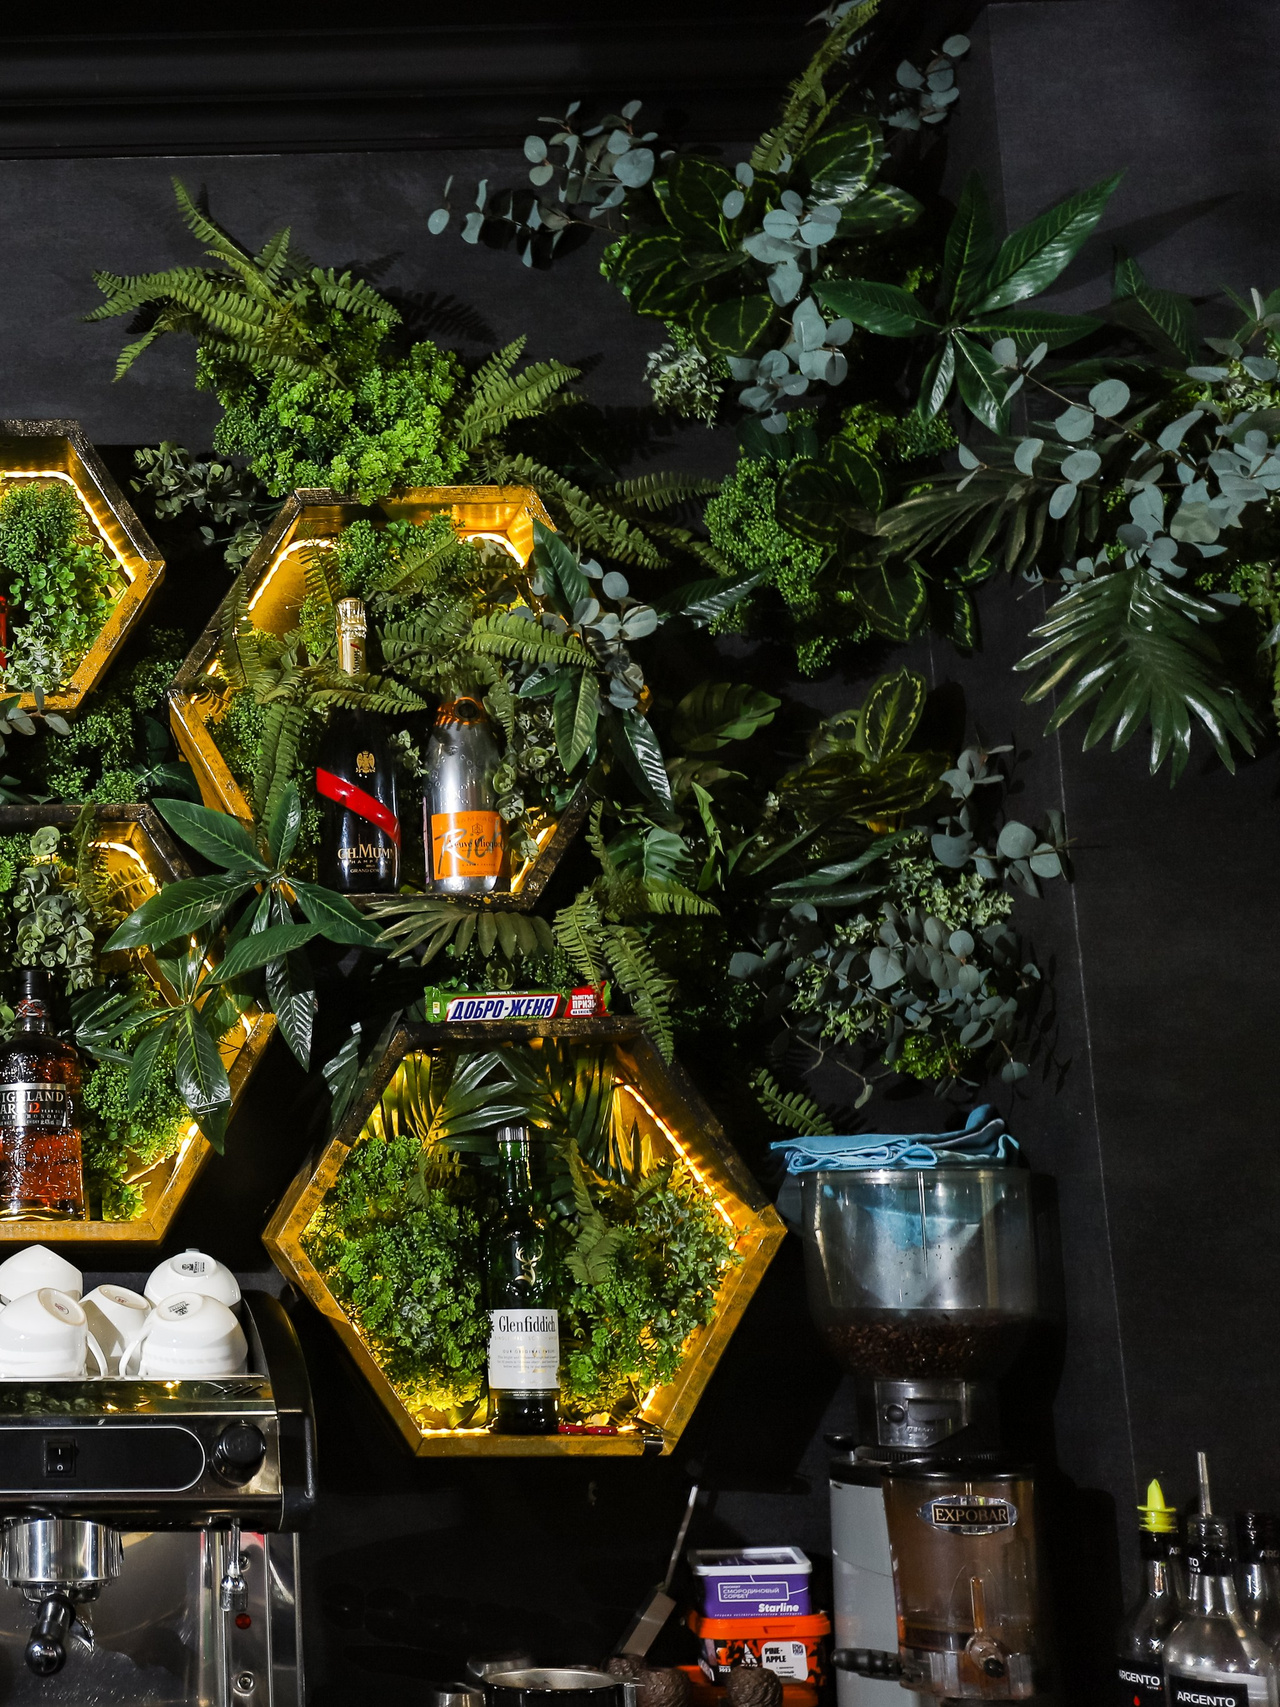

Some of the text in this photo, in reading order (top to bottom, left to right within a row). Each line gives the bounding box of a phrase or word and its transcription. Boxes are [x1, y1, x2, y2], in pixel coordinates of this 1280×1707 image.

[434, 817, 502, 875] Rich
[450, 997, 555, 1021] ДОБРО-ЖЕНЯ
[28, 1102, 41, 1113] 12
[498, 1315, 556, 1333] Glenfiddich
[935, 1508, 1007, 1522] EXPOBAR
[758, 1602, 800, 1613] Starline
[765, 1655, 787, 1663] APPLE
[1176, 1690, 1237, 1707] ARGENTO
